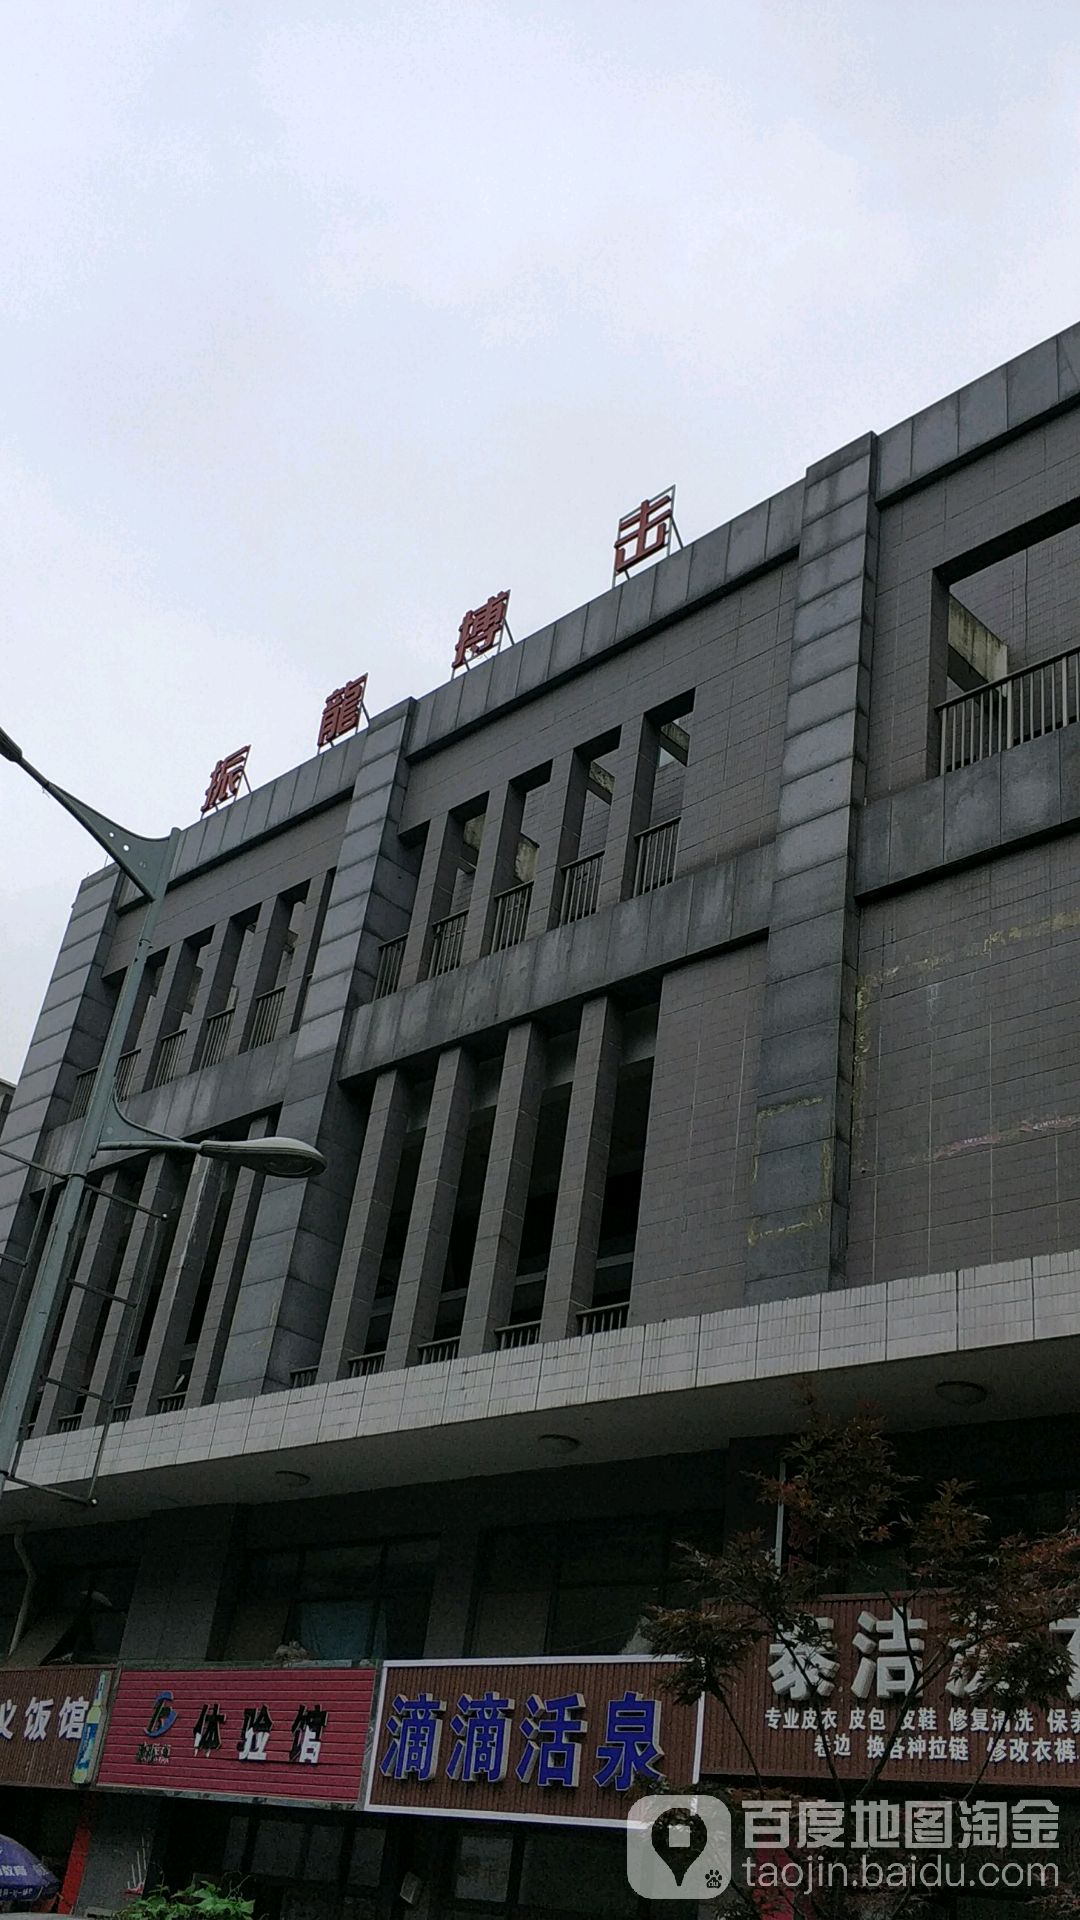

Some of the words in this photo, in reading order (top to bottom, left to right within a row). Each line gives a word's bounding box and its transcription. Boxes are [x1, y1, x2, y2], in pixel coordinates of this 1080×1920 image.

[201, 492, 673, 814] 振龍搏击
[379, 1692, 664, 1791] 滴滴活泉
[764, 1707, 838, 1731] 专业皮衣
[849, 1708, 886, 1731] 皮包
